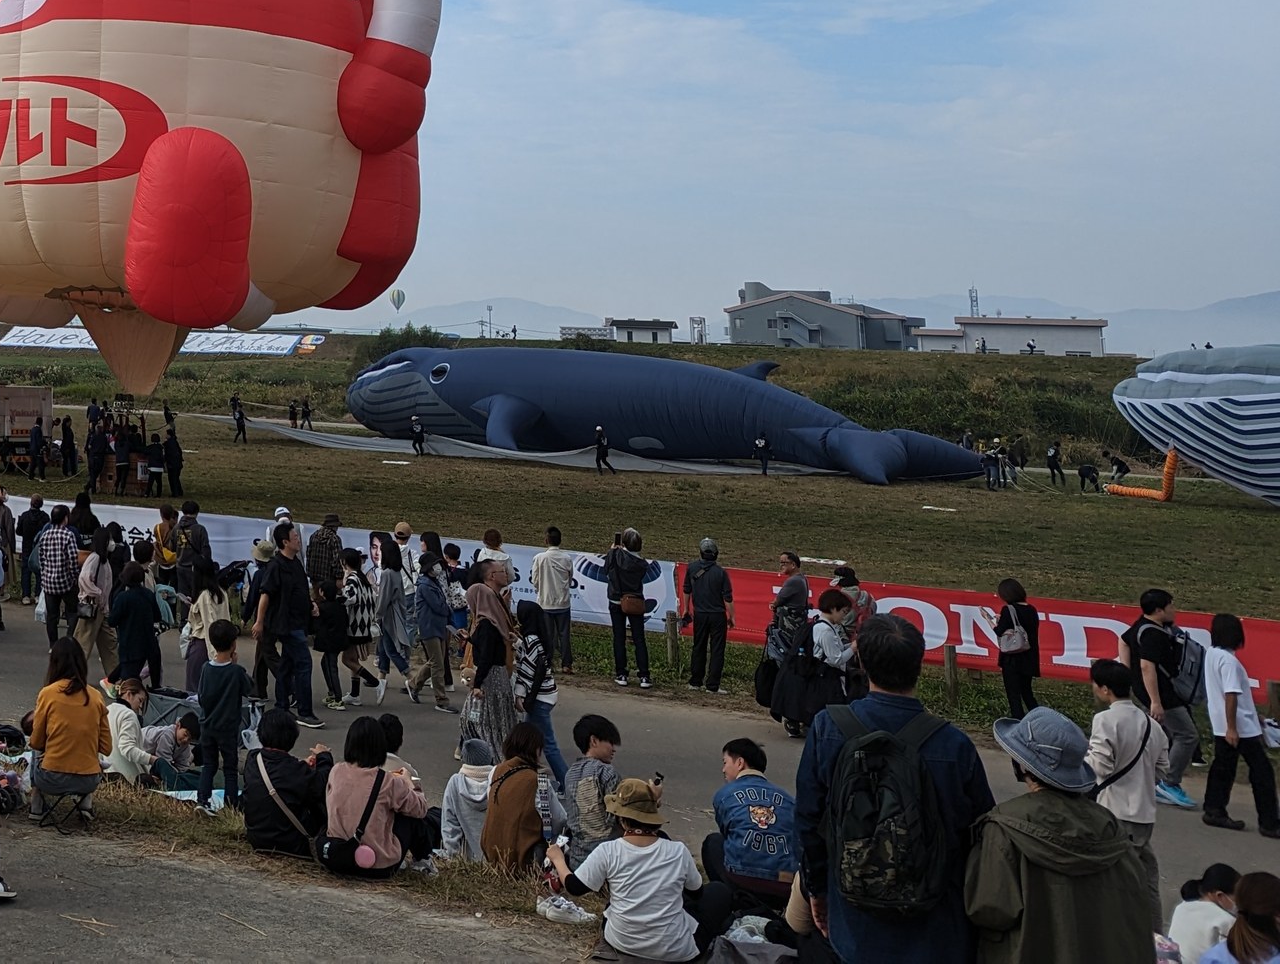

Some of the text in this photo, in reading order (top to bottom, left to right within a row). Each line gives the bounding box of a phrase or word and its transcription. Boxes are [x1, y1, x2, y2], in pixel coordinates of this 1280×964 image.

[3, 328, 79, 345] Have
[733, 787, 784, 807] POLO
[742, 829, 790, 855] 1967
